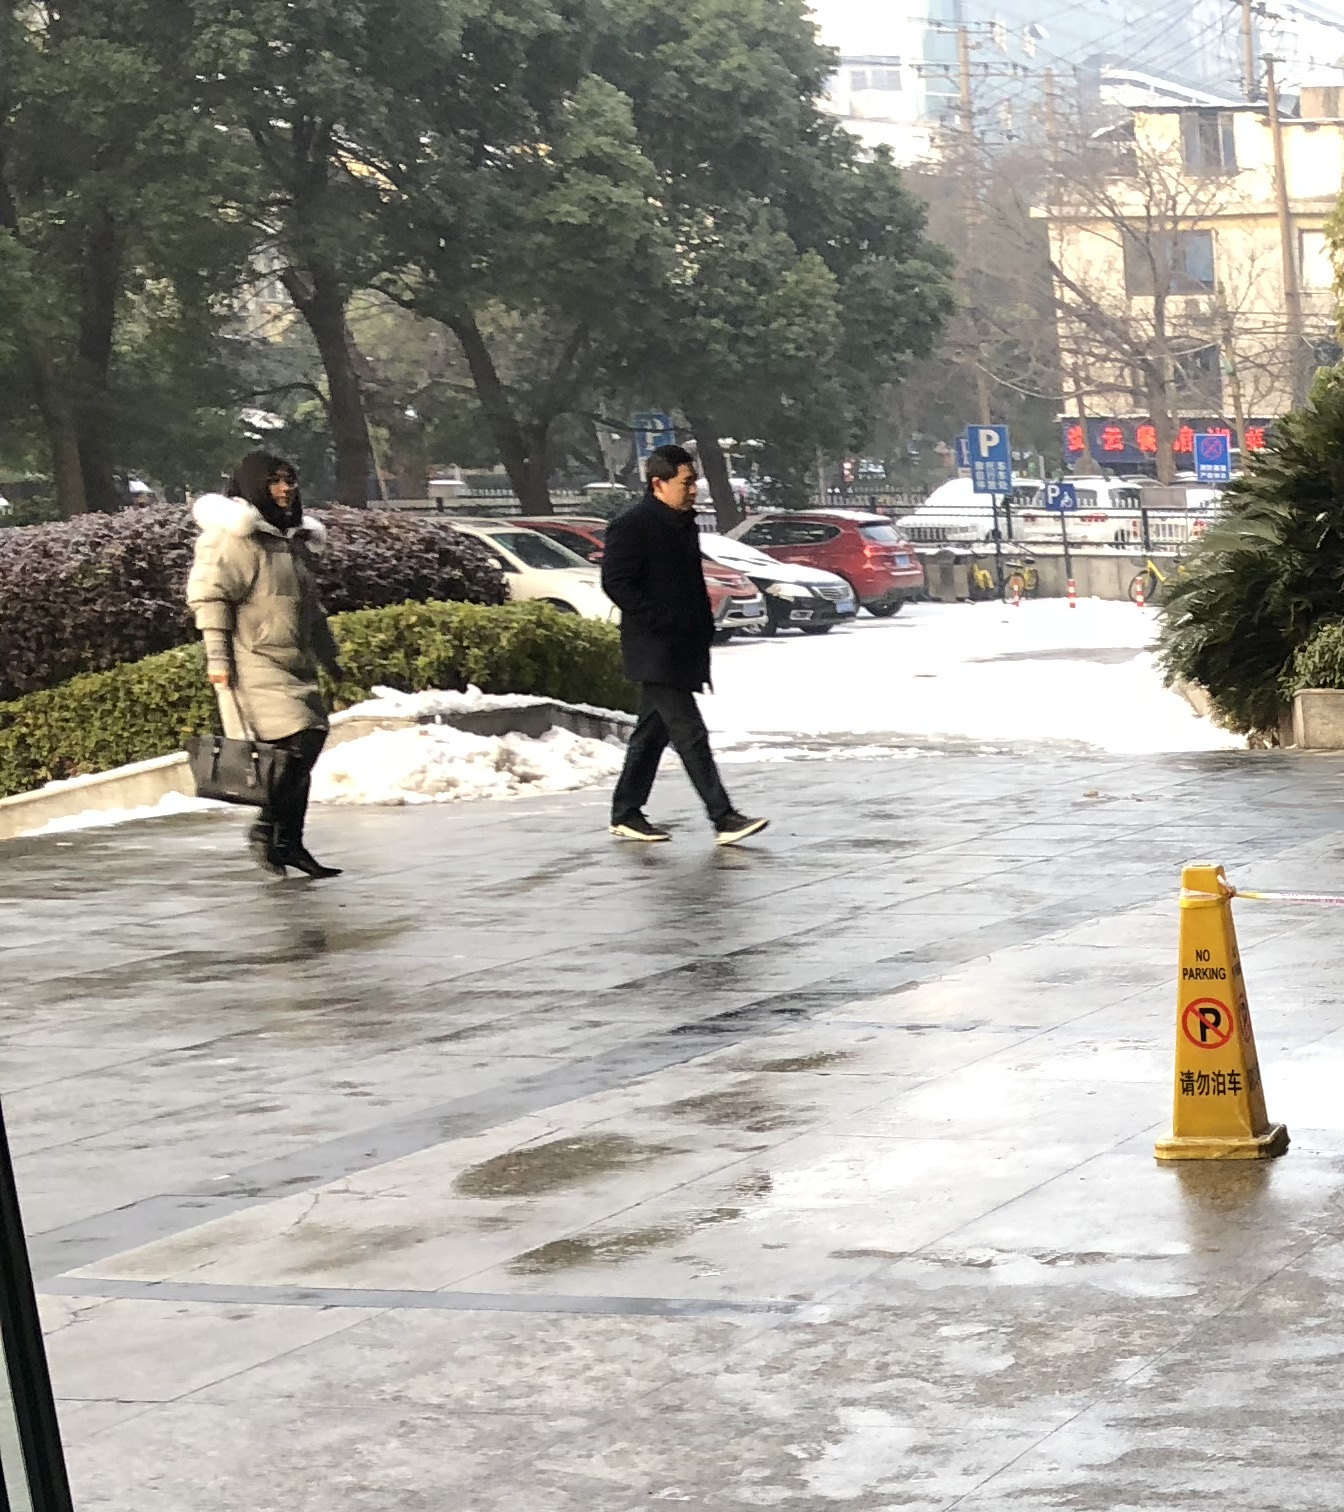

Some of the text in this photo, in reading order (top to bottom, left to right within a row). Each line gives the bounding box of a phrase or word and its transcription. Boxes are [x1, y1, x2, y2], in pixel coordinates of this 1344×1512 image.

[1196, 950, 1210, 962] NO
[1182, 967, 1227, 980] PARKING
[1180, 1069, 1242, 1096] 请勿泊车
